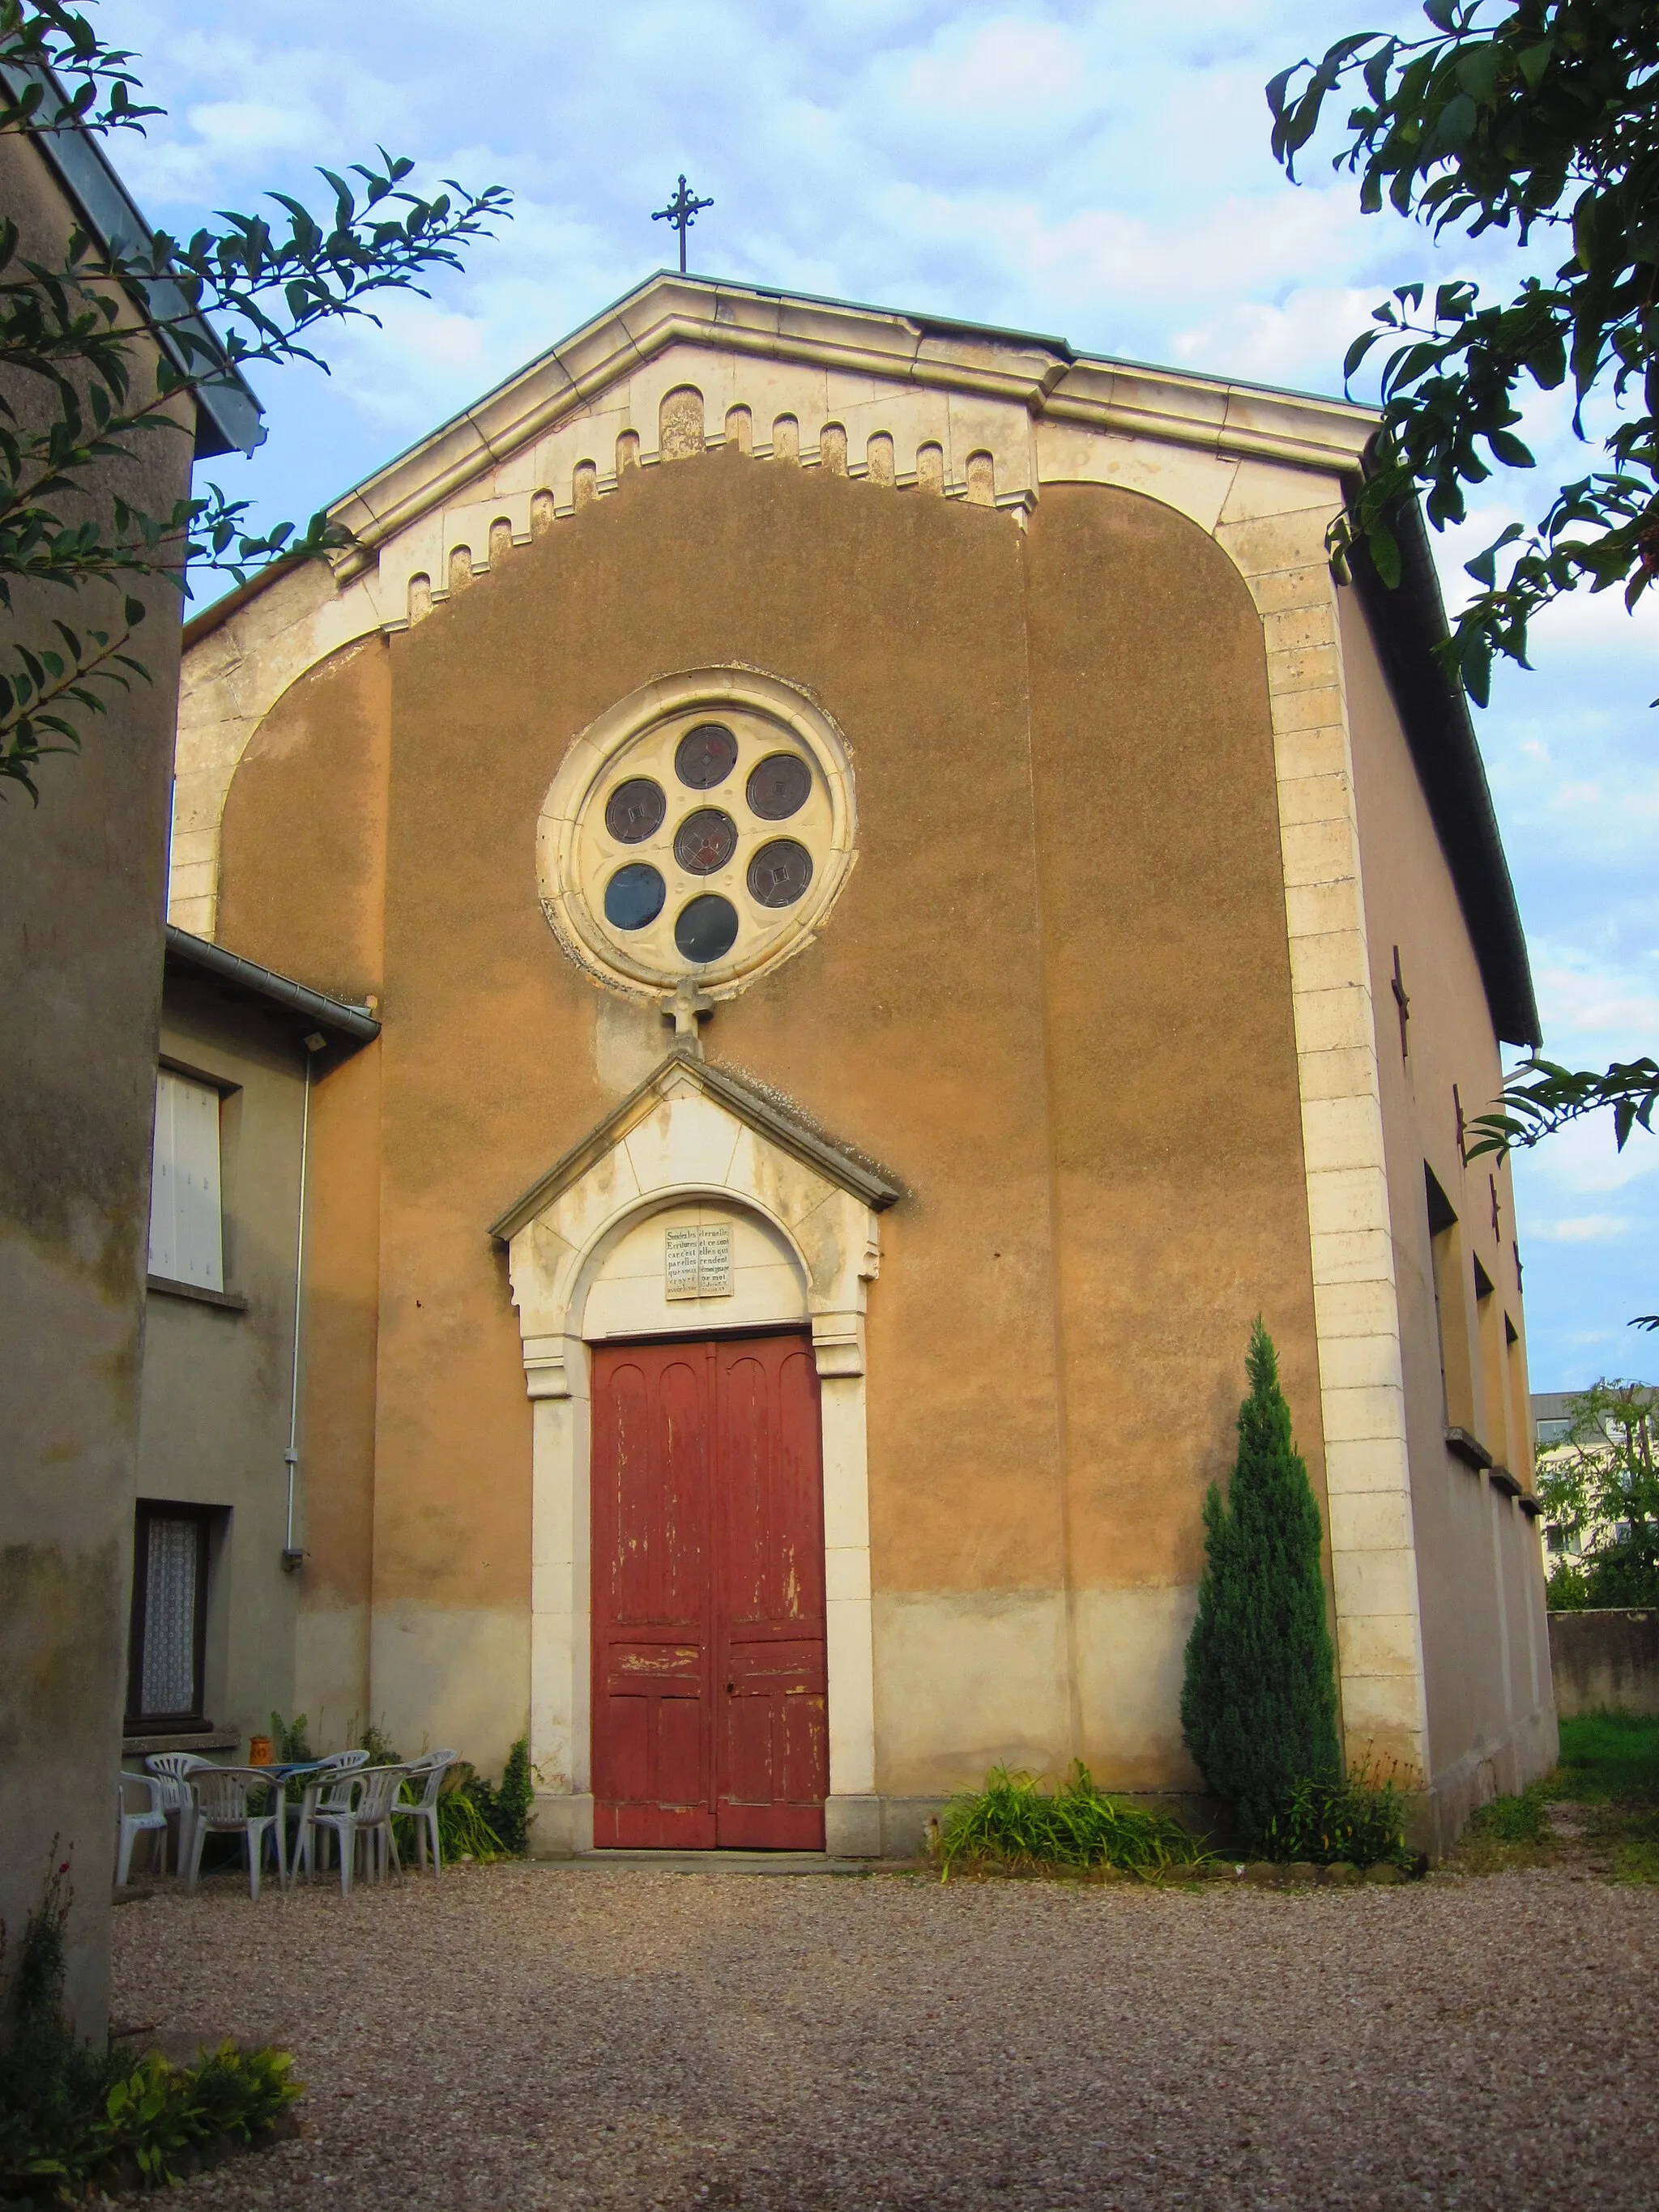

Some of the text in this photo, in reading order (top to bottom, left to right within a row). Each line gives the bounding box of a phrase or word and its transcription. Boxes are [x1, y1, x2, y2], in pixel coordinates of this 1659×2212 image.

[700, 1247, 716, 1255] elles
[668, 1257, 697, 1270] par elles
[700, 1256, 727, 1264] rendent
[667, 1270, 680, 1278] que
